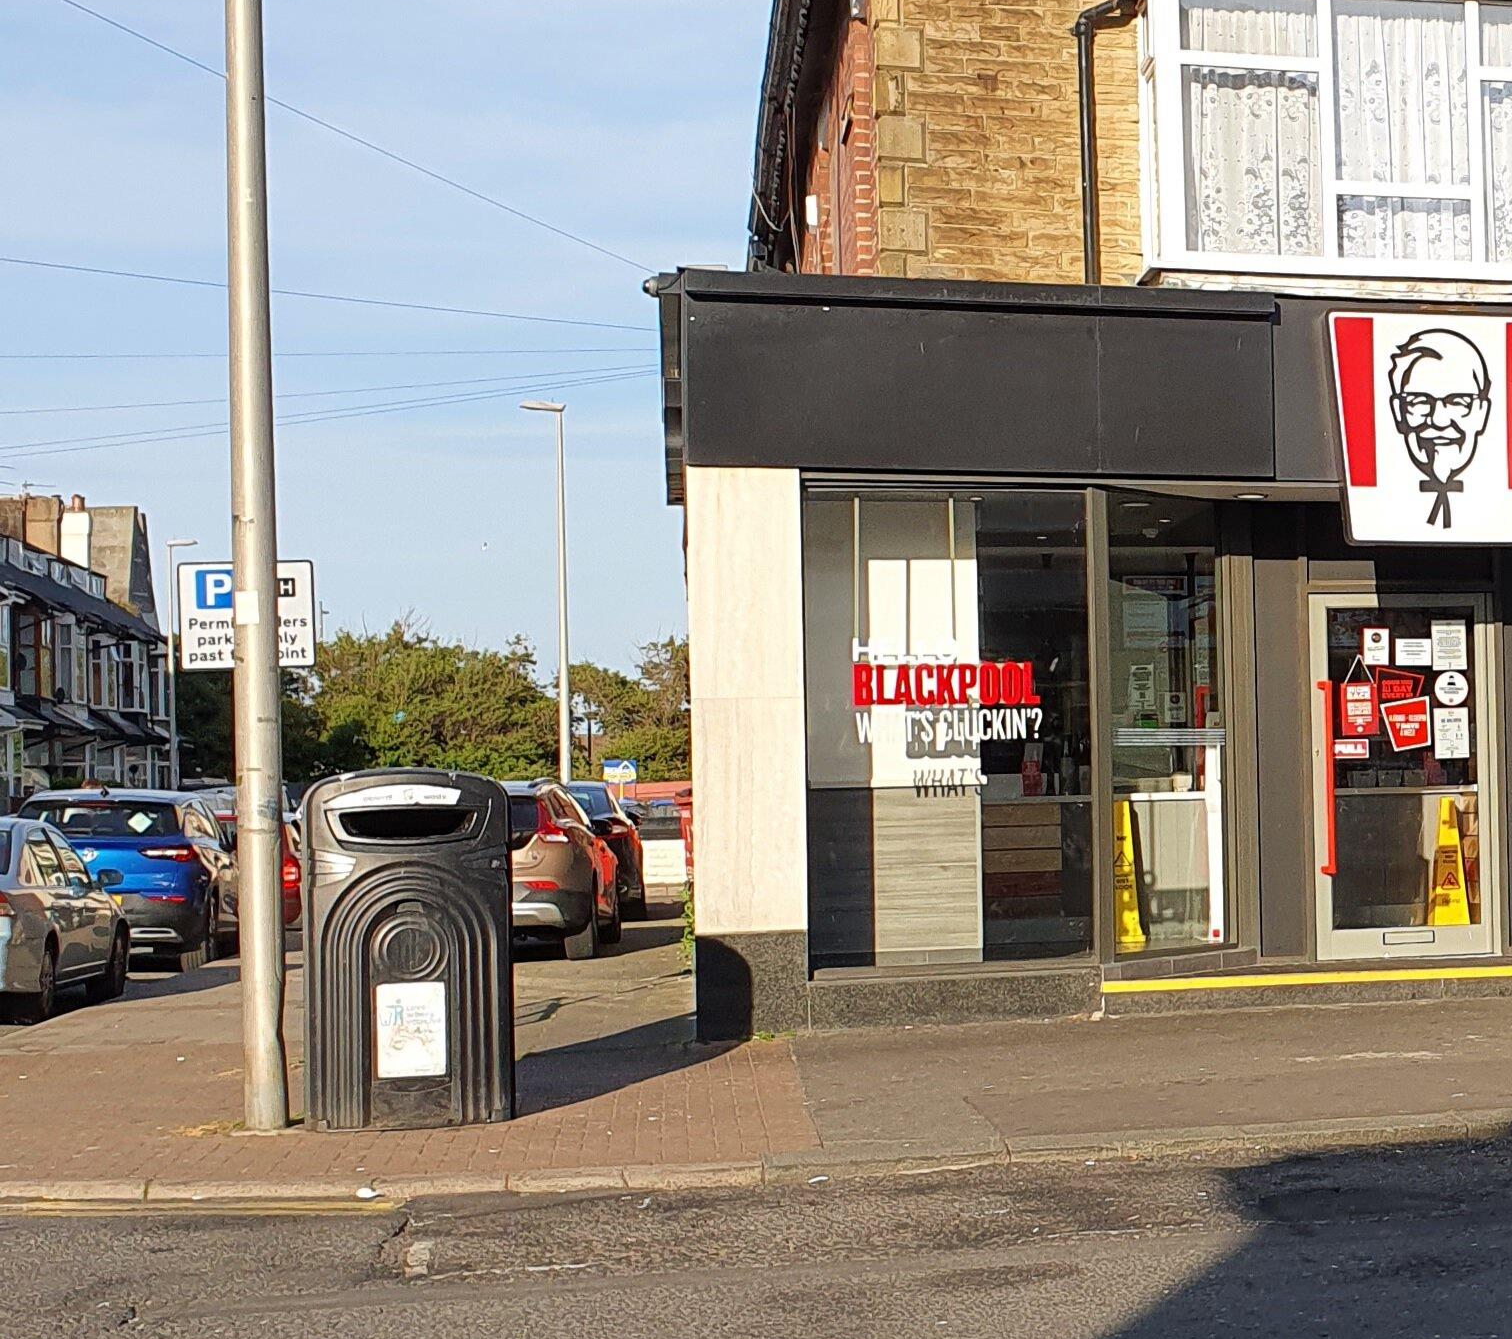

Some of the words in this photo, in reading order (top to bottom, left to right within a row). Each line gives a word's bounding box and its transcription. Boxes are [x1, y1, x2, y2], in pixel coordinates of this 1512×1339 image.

[206, 573, 232, 606] P
[189, 617, 236, 630] Permi
[197, 633, 235, 648] park
[278, 631, 297, 645] ly
[189, 649, 225, 664] past
[278, 647, 307, 660] oint
[853, 661, 1041, 706] BLACKPOOL
[855, 710, 934, 744] WT'S
[940, 708, 1043, 742] CLUCKIN'?
